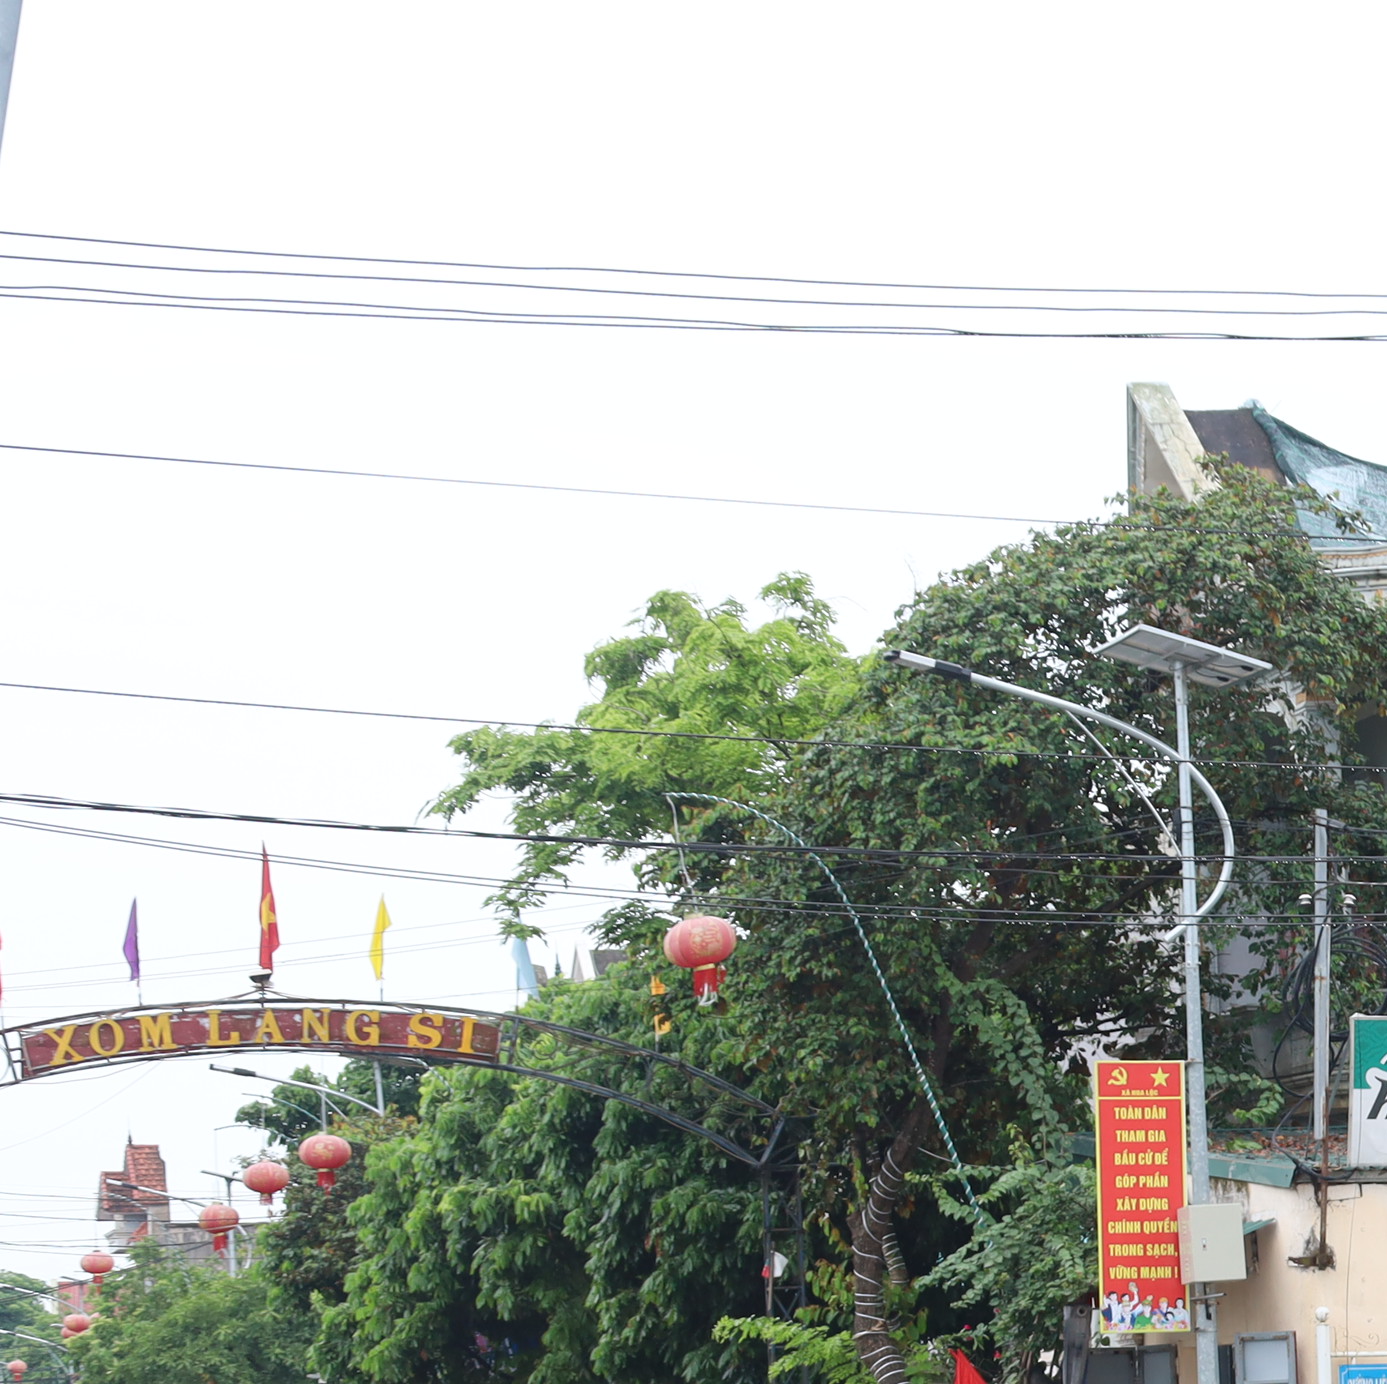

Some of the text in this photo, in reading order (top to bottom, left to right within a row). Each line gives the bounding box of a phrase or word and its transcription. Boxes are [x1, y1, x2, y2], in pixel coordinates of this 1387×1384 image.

[206, 1008, 381, 1047] LANG
[407, 1013, 479, 1054] SI
[1113, 1104, 1167, 1120] TOÀN DÂN
[1115, 1129, 1167, 1143] THAM GIA
[1115, 1173, 1137, 1188] GÓP
[1116, 1196, 1169, 1213] XÂY DỰNG
[1108, 1218, 1141, 1234] CHÍNH
[1108, 1244, 1144, 1256] TRONG
[1109, 1264, 1138, 1279] VỮNG
[1140, 1266, 1171, 1281] MẠNH
